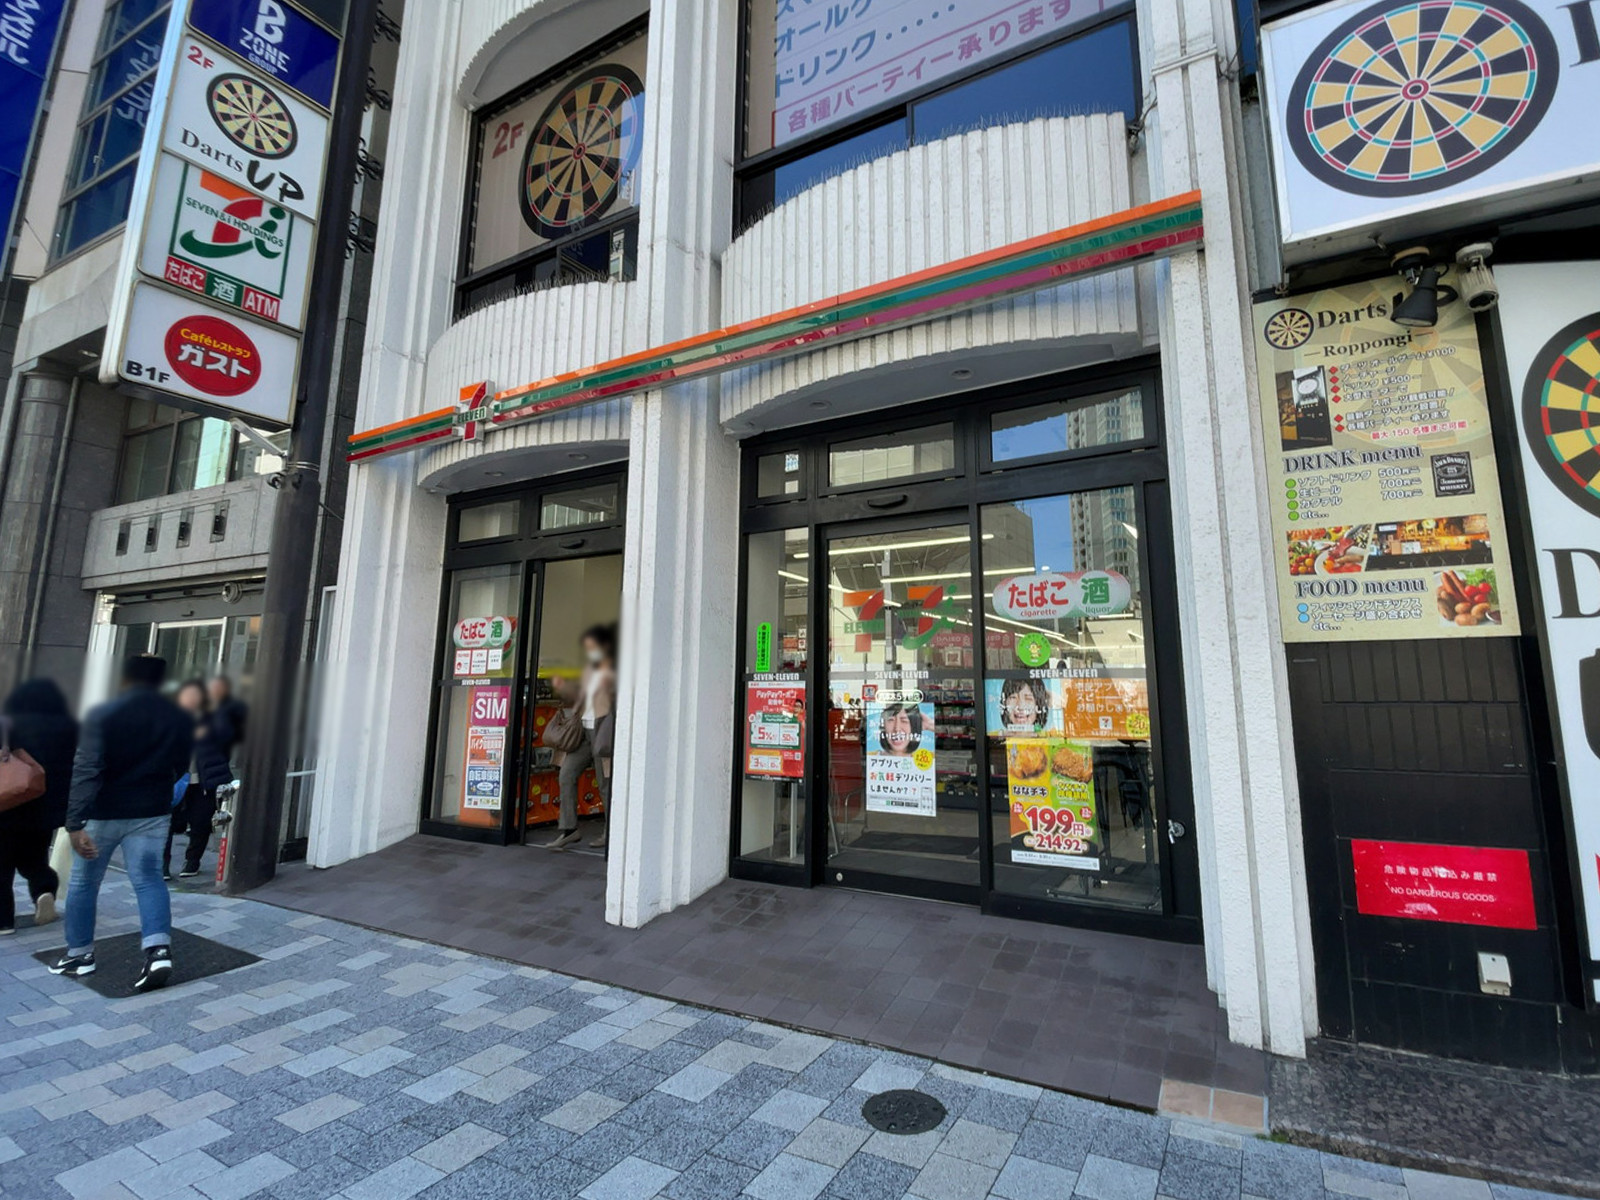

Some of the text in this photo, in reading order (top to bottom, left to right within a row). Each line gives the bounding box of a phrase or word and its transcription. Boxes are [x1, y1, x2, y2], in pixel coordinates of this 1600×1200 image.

[186, 44, 216, 70] 2F
[239, 26, 291, 74] ZONE
[180, 127, 245, 173] Darts
[491, 121, 525, 160] 2F
[233, 217, 285, 248] HOLDINGS
[166, 260, 279, 320] たばこ 酒 ATM
[1315, 303, 1388, 330] Darts
[1322, 330, 1414, 359] Roppongi
[125, 359, 171, 384] B1F
[176, 343, 252, 379] ガスト
[1282, 444, 1424, 475] DRINK menu
[1007, 577, 1110, 609] たばこ 酒
[1294, 577, 1429, 599] FOOD menu
[1019, 608, 1057, 618] cigarette
[459, 620, 504, 640] たばこ 酒
[474, 697, 508, 720] SIM
[1390, 886, 1496, 903] NO DANGEROUS GOODS
